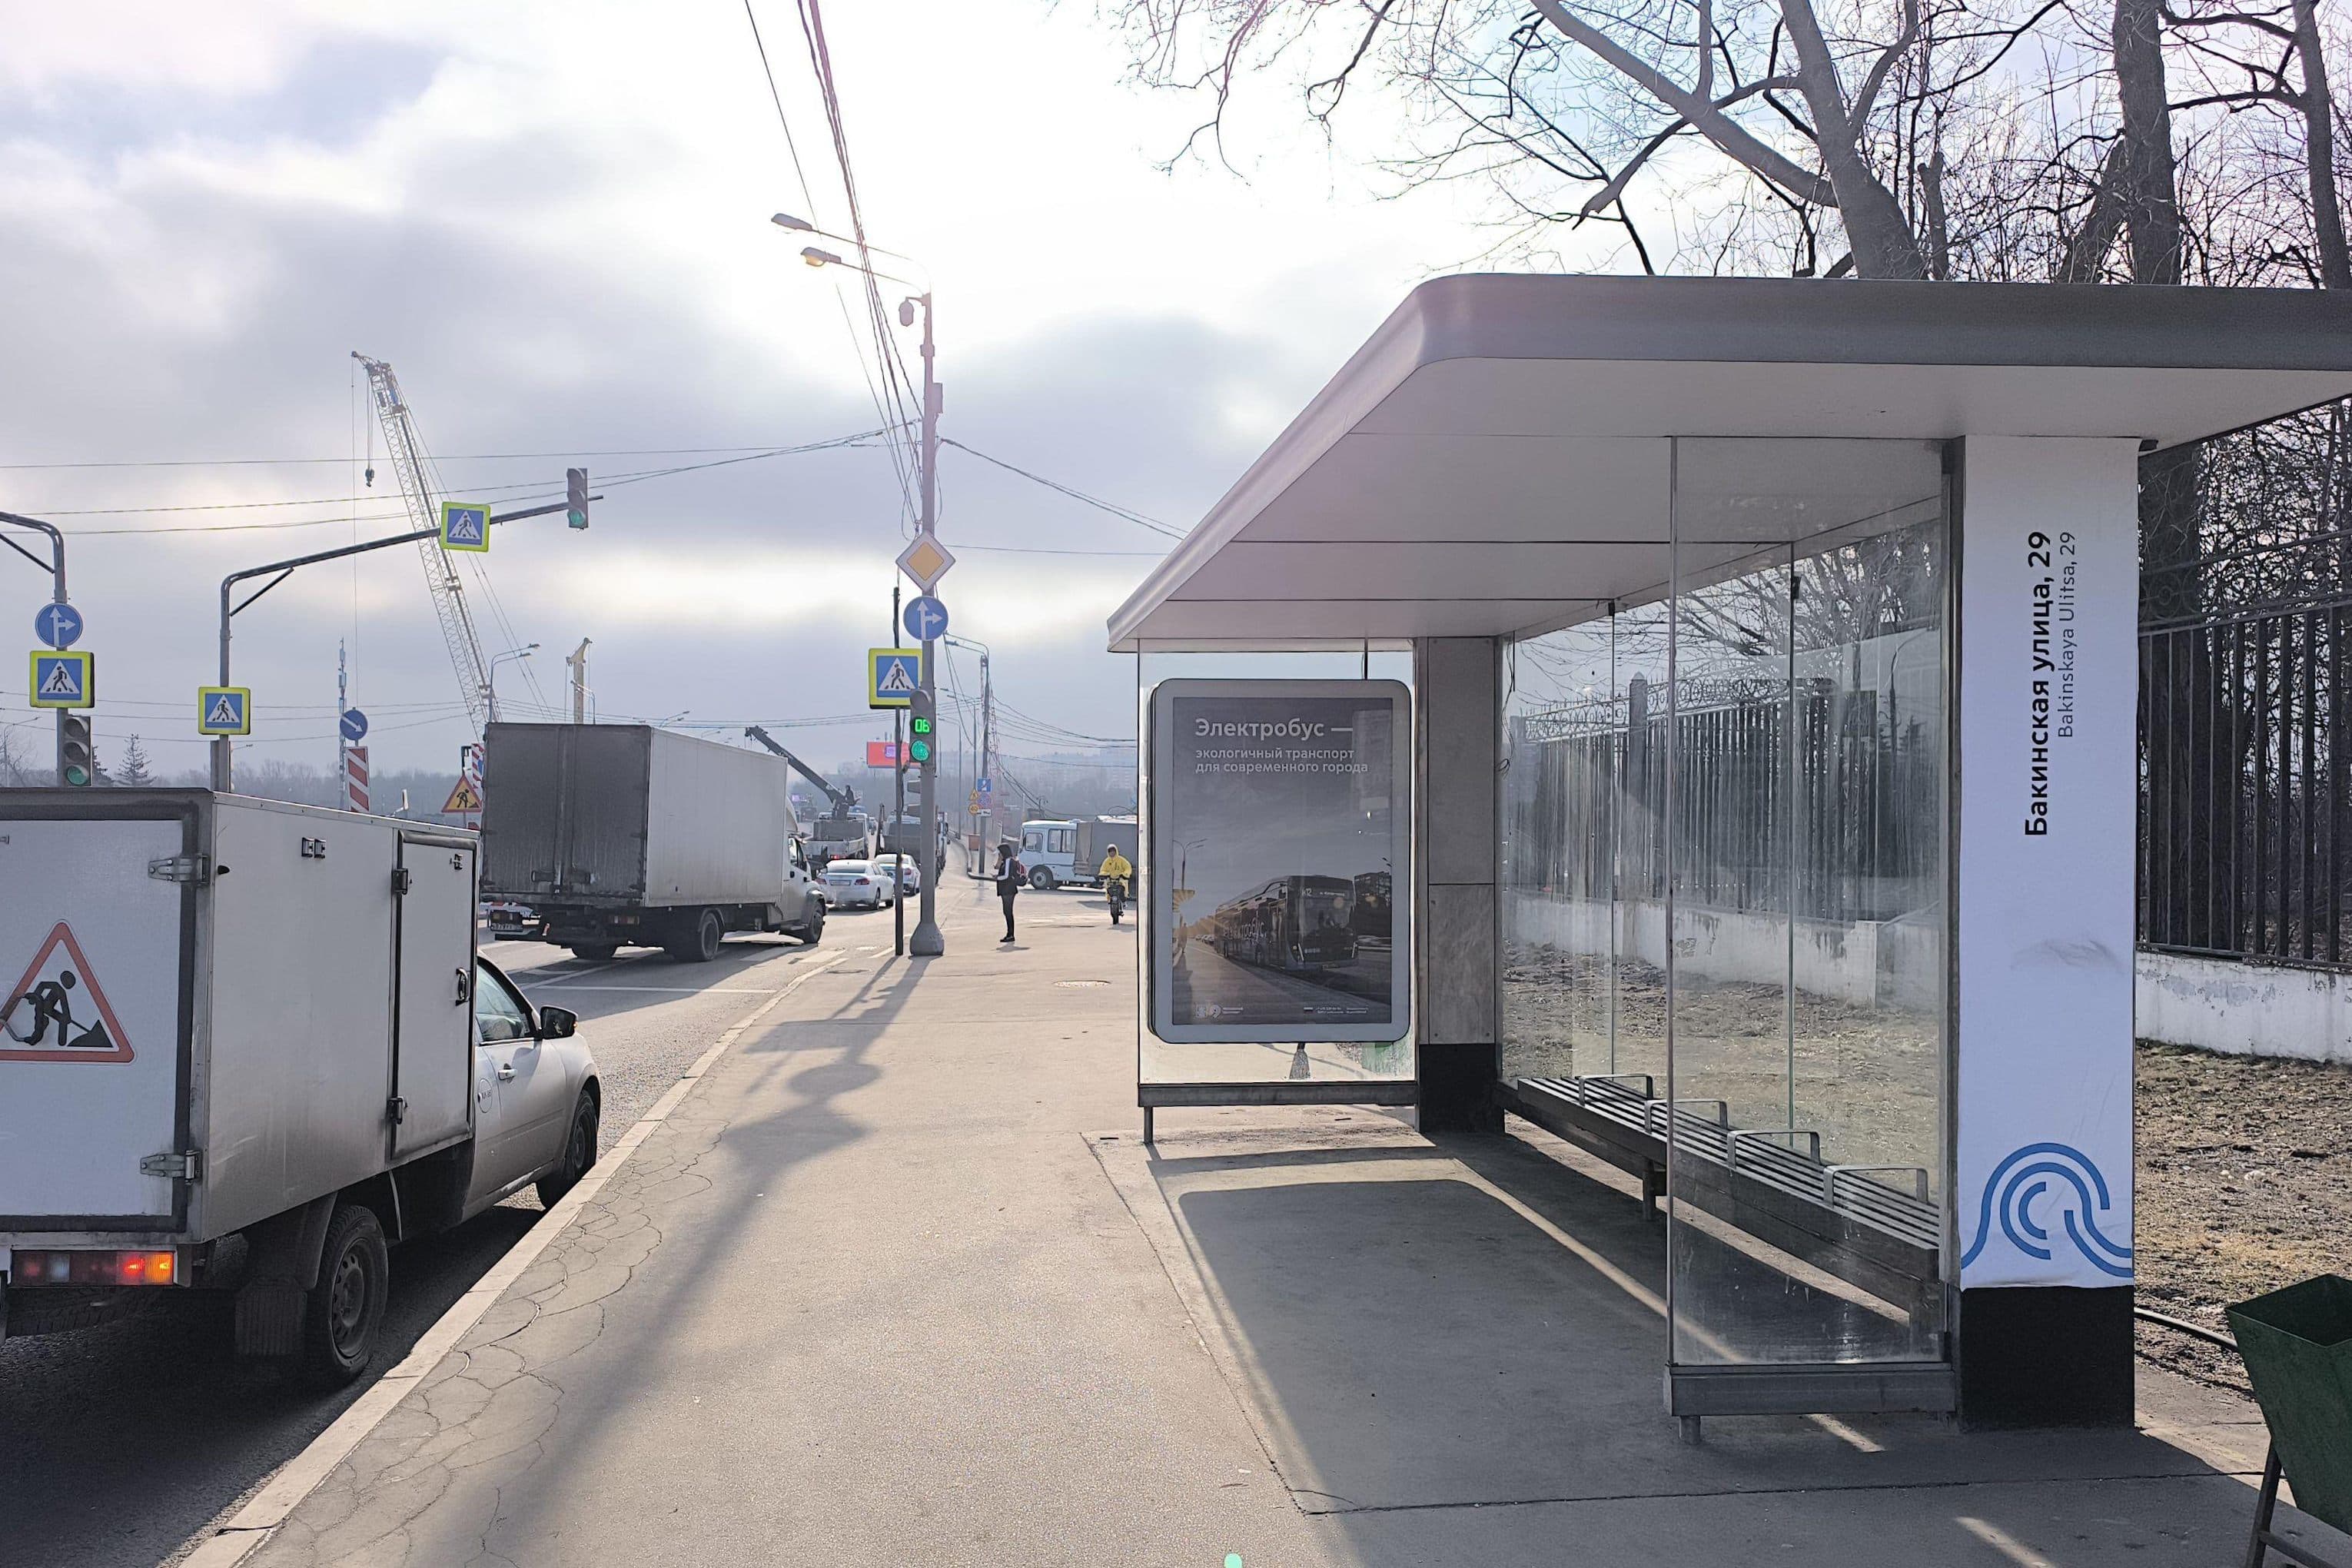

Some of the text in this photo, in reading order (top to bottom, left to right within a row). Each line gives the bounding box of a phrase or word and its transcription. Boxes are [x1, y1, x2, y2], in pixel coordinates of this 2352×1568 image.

[2058, 531, 2078, 738] Bakinskaya Ulitsa, 29
[2025, 531, 2055, 835] Бакинская улица, 29
[1195, 718, 1324, 741] Электробус
[1196, 747, 1354, 760] экологичный транспорт
[1195, 762, 1368, 774] для современного города
